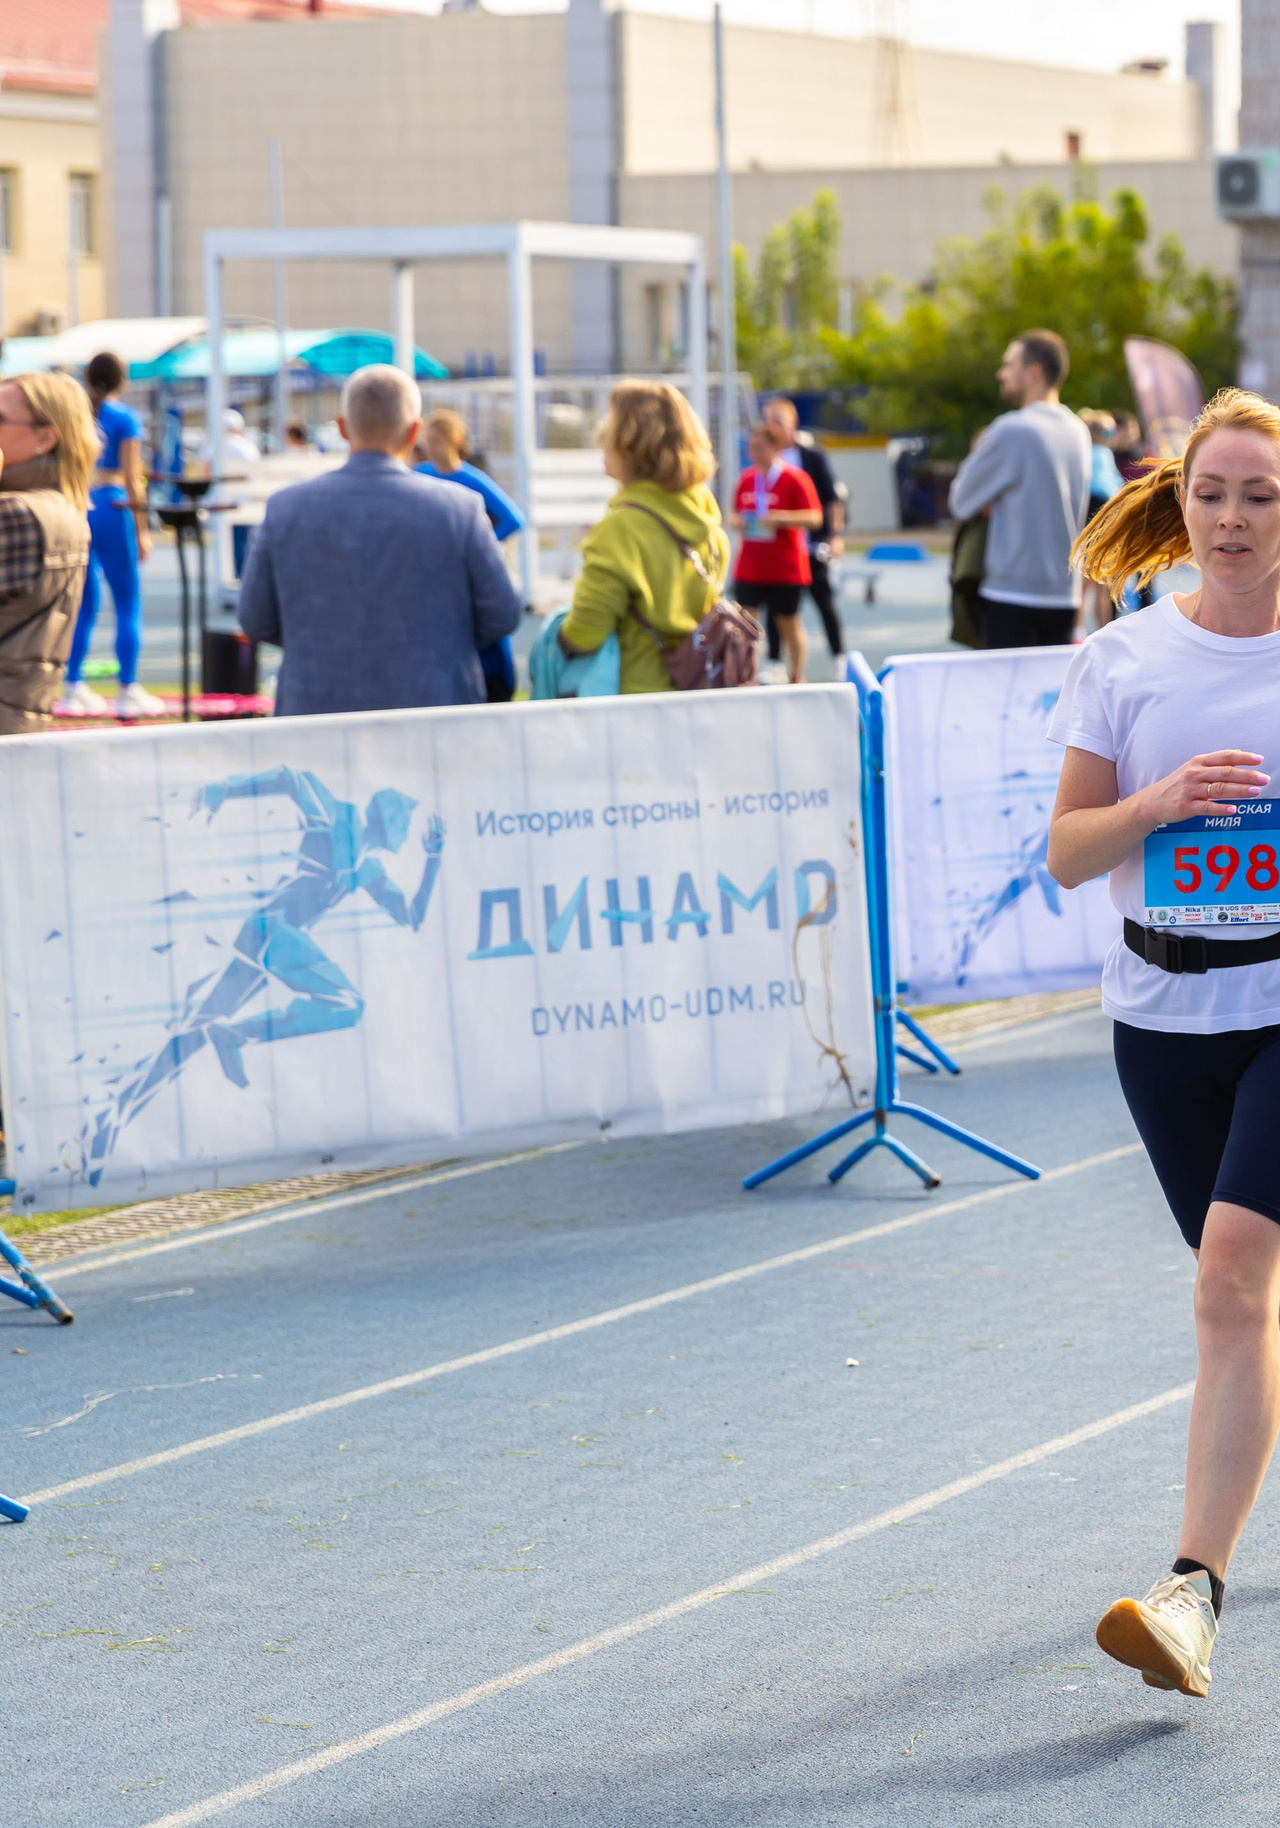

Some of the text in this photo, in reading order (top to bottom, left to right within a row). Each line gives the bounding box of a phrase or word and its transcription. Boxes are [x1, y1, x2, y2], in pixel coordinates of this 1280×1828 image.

[476, 807, 594, 838] История
[602, 798, 701, 830] страны
[724, 788, 829, 817] история
[1205, 816, 1242, 828] МИЛЯ
[1174, 843, 1280, 894] 598
[466, 859, 838, 961] ДИНАМО
[532, 979, 806, 1037] DYNAMO-UDM.RU
